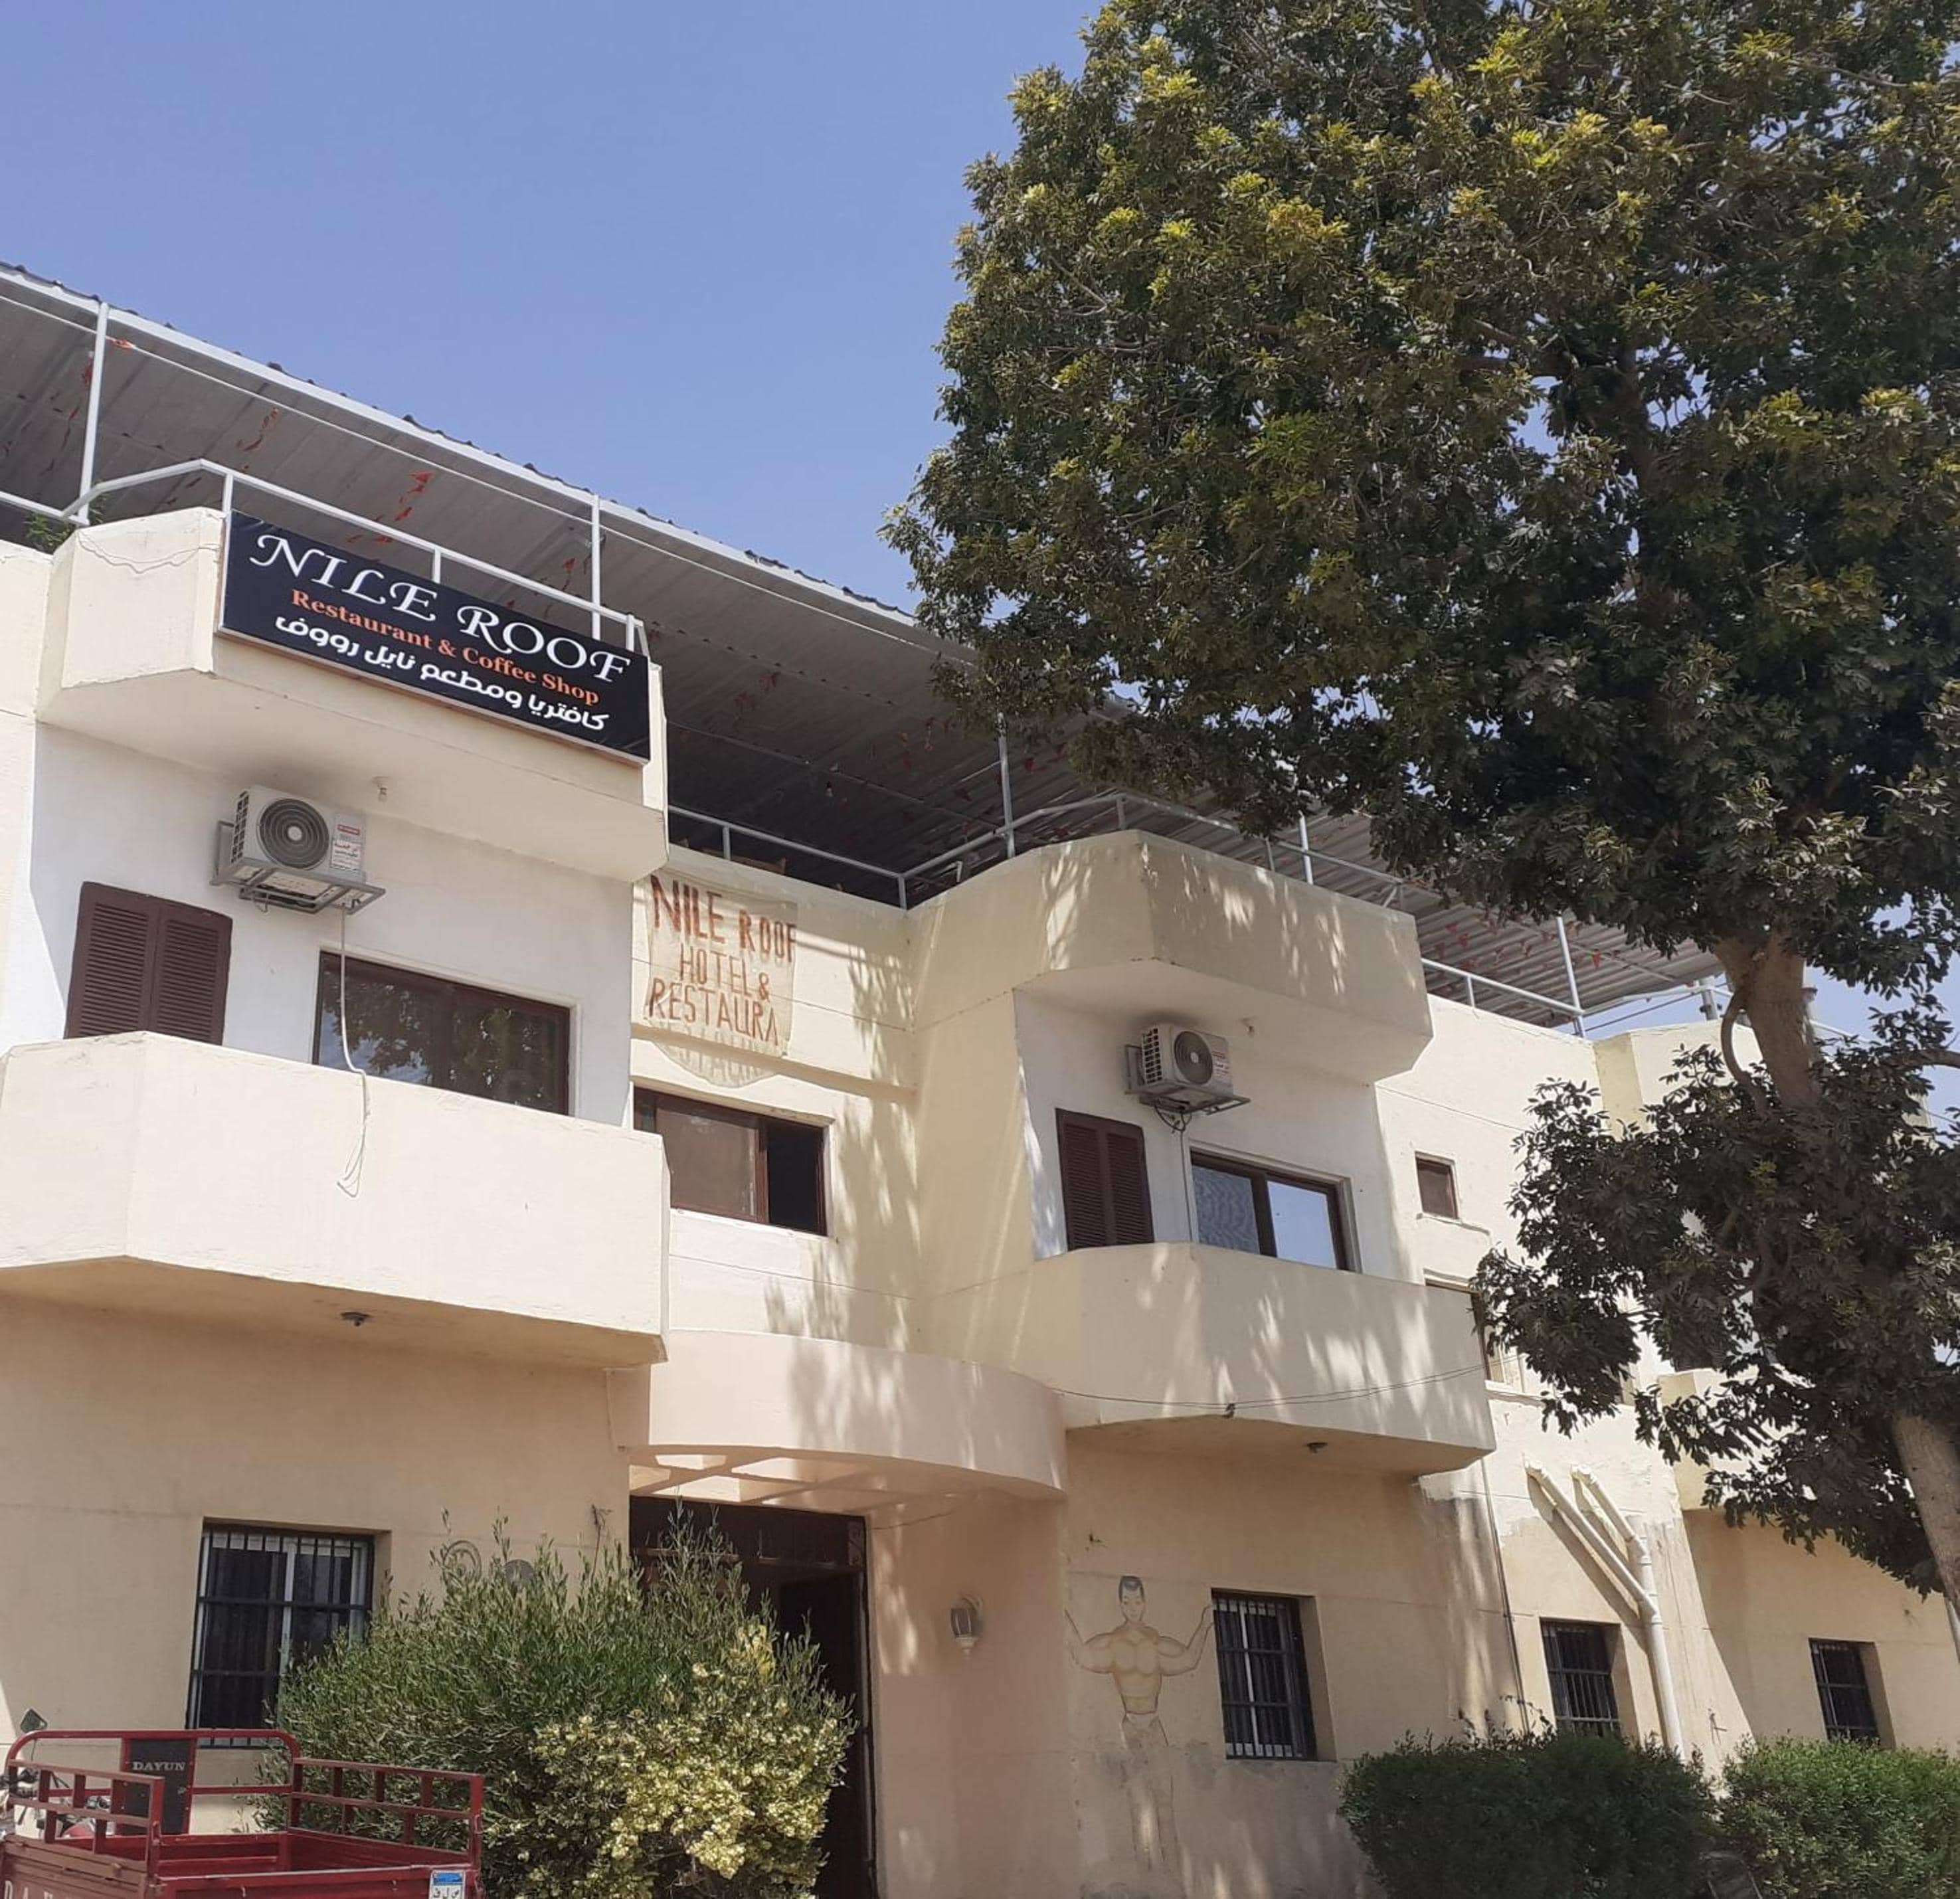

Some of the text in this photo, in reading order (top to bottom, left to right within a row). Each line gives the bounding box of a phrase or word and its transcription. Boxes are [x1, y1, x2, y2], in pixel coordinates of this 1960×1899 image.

[249, 534, 631, 682] NILE ROOF
[292, 588, 599, 705] Restaurant & Coffee Shop
[275, 616, 610, 731] كافتريا ومطعم نايل رووف
[650, 873, 798, 963] NILE ROOF
[679, 943, 770, 1003] HOTEL &
[132, 1762, 186, 1771] DAYUN
